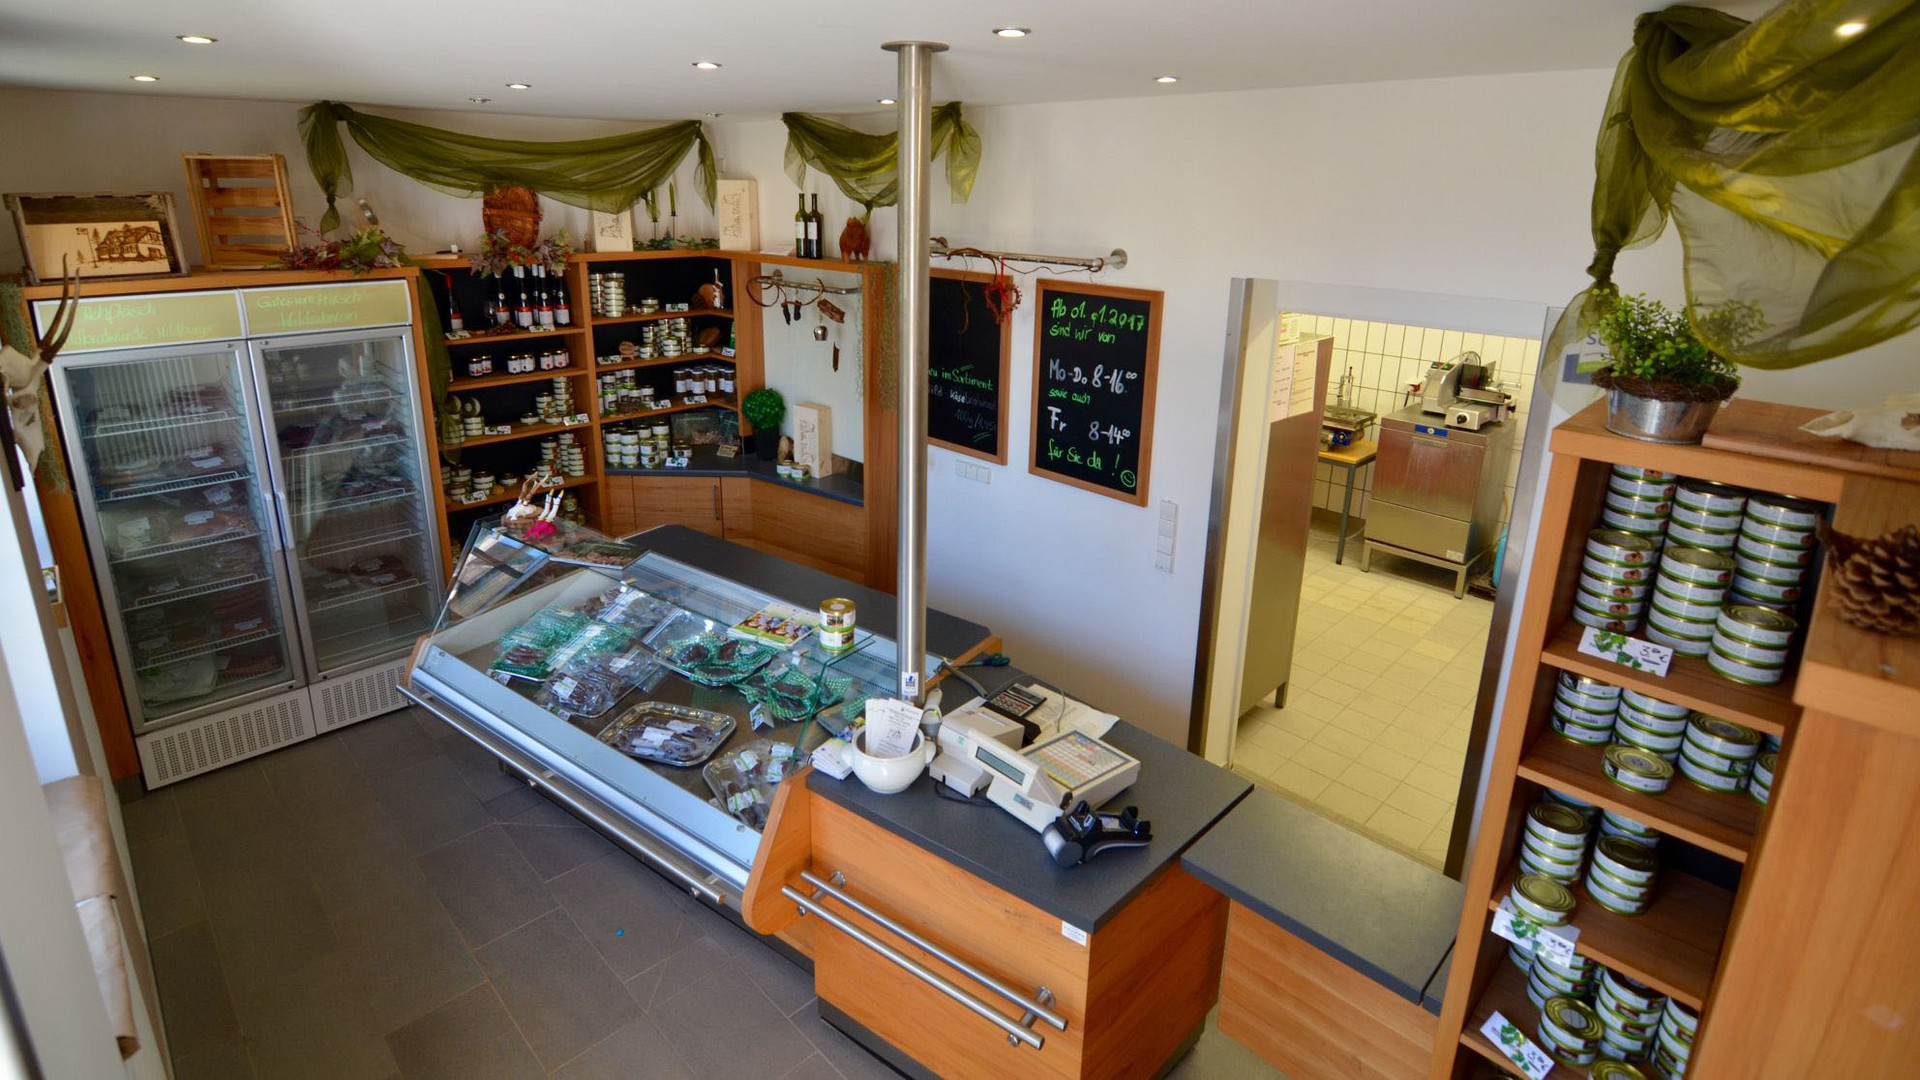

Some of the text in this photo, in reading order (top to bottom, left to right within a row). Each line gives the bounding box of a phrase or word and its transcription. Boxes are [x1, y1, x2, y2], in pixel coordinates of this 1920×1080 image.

[1051, 298, 1067, 319] Ab
[1075, 325, 1093, 341] wir
[1098, 332, 1116, 344] von
[928, 368, 938, 377] eu
[1071, 392, 1091, 405] auch
[1047, 406, 1068, 432] Fr
[1048, 438, 1064, 461] für
